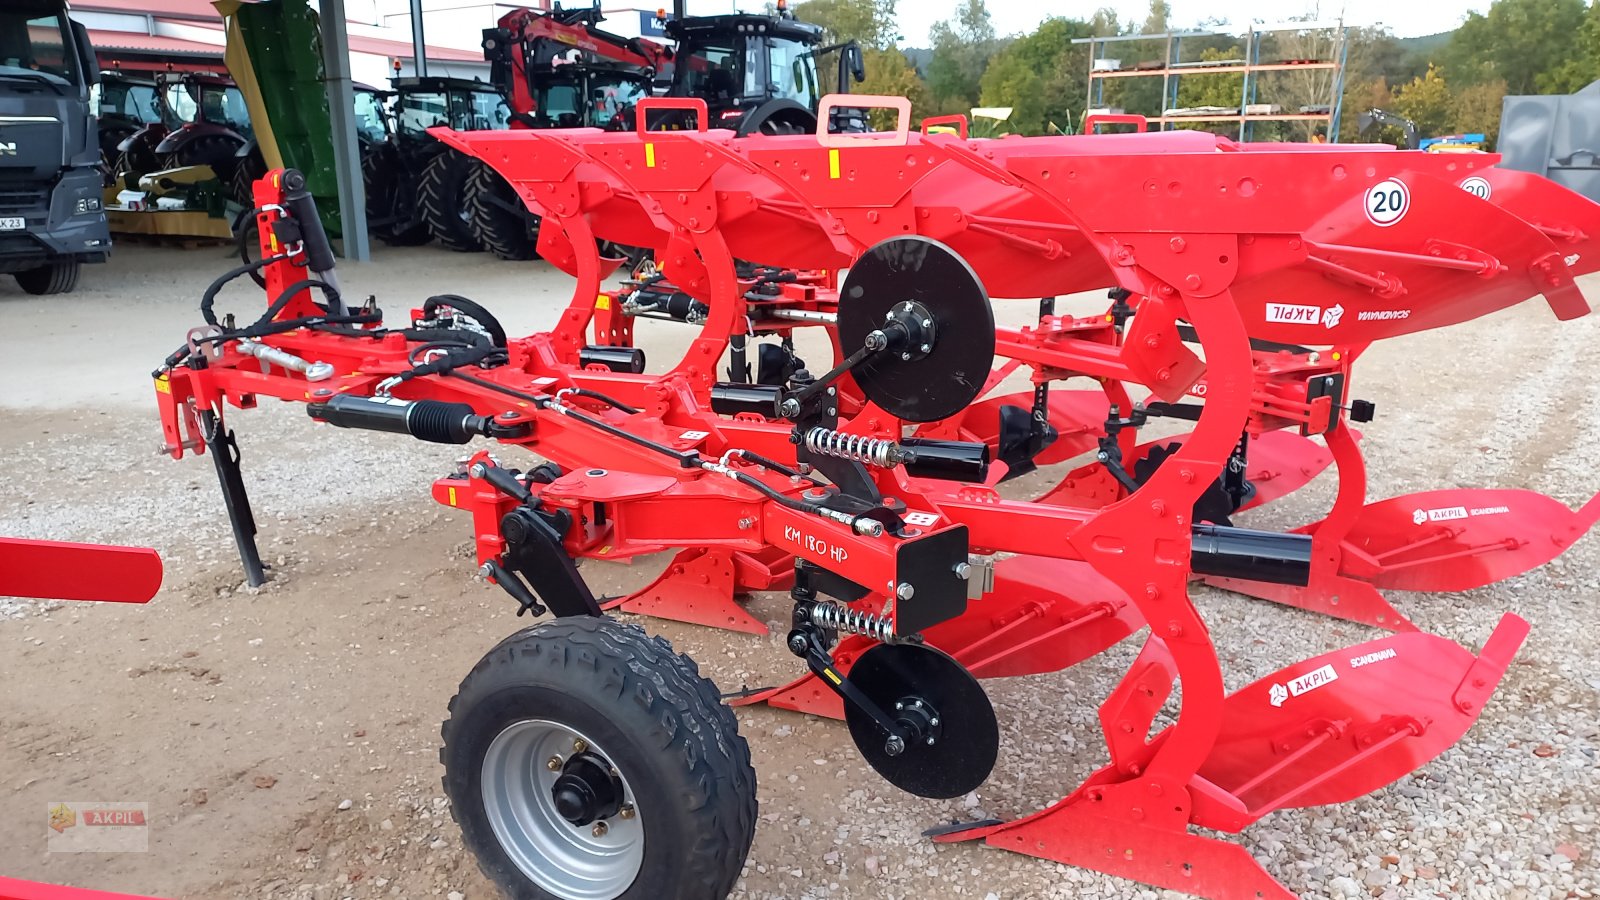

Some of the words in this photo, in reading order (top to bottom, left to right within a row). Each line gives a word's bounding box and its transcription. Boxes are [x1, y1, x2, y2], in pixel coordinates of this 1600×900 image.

[1373, 189, 1403, 213] 20
[1273, 306, 1316, 321] AKPIL
[1357, 309, 1411, 321] SCANDINAVIA
[1433, 509, 1463, 519] AKPIL
[784, 525, 801, 545] KM
[804, 534, 827, 555] 180
[830, 545, 848, 564] HP
[1295, 669, 1332, 693] AKPIL
[1349, 647, 1398, 669] SCANDINAVIA
